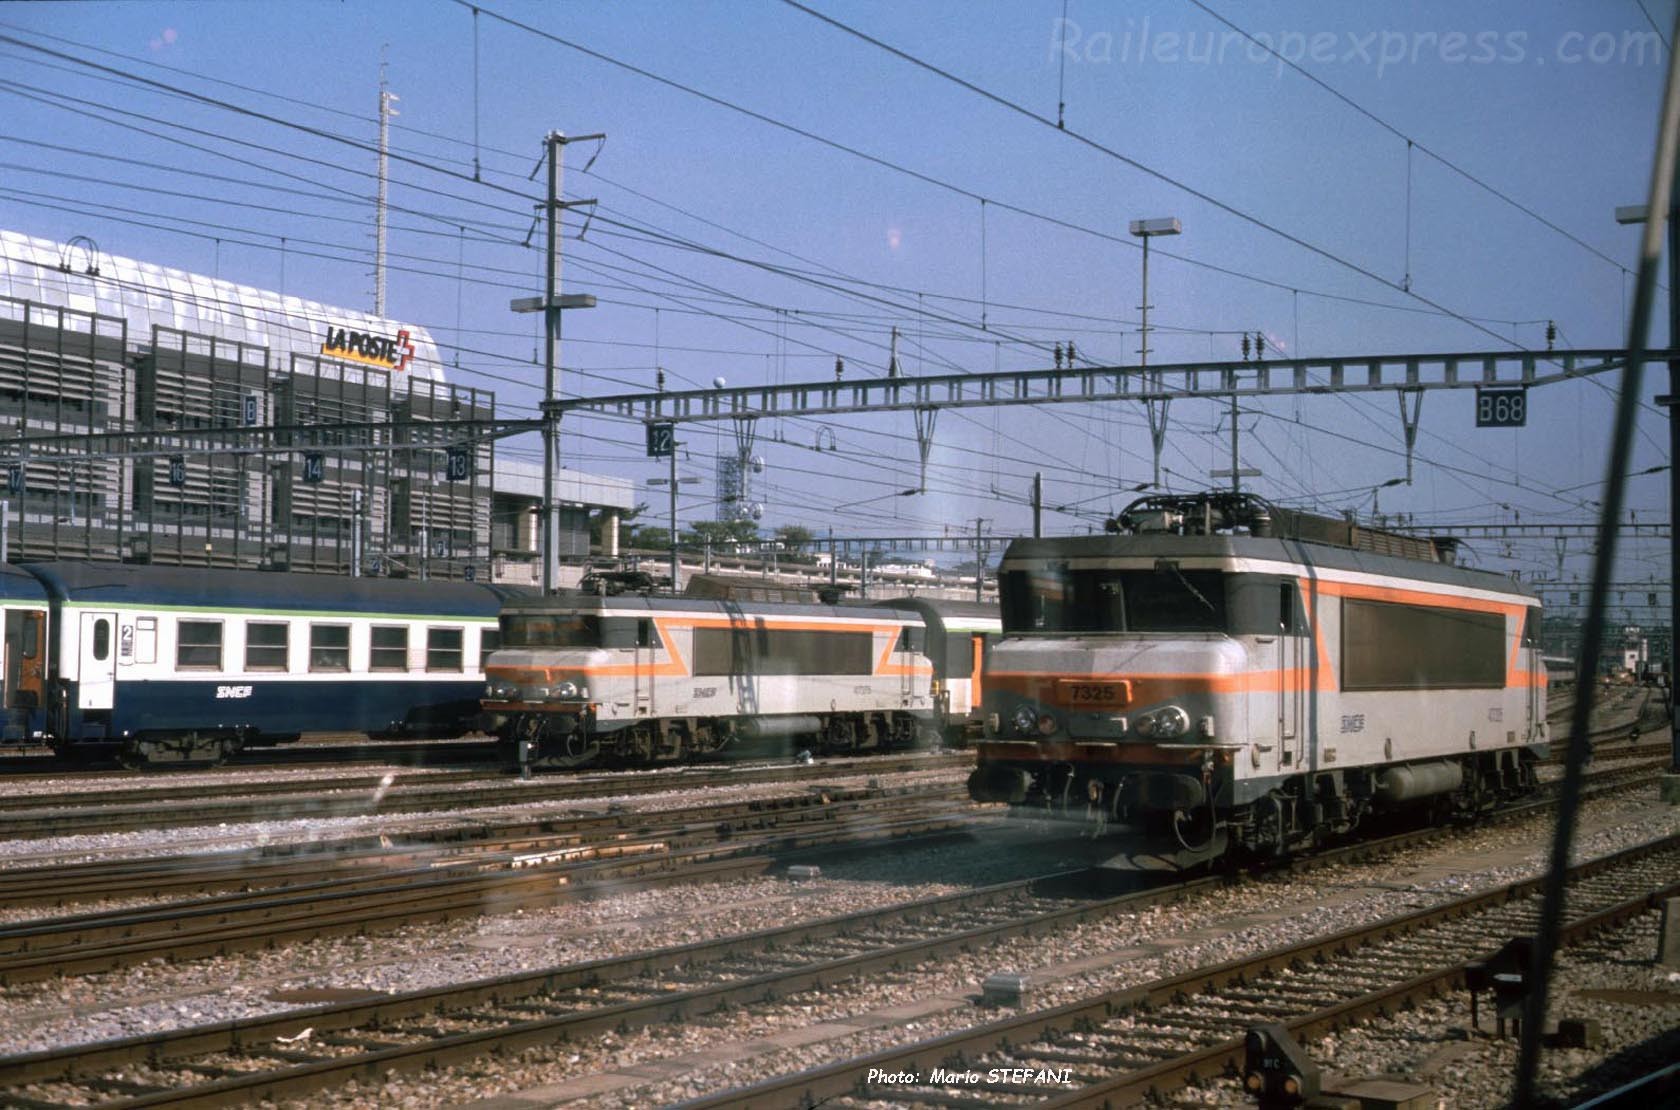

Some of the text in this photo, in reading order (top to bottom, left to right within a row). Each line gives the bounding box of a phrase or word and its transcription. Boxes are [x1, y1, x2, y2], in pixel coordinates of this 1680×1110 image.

[326, 326, 398, 364] LA POSTE
[1480, 396, 1524, 421] B68
[652, 430, 671, 451] 12
[307, 458, 321, 479] 14
[450, 455, 466, 476] 13
[123, 626, 132, 641] 2
[216, 685, 253, 699] SNCF
[1071, 686, 1115, 700] 7325
